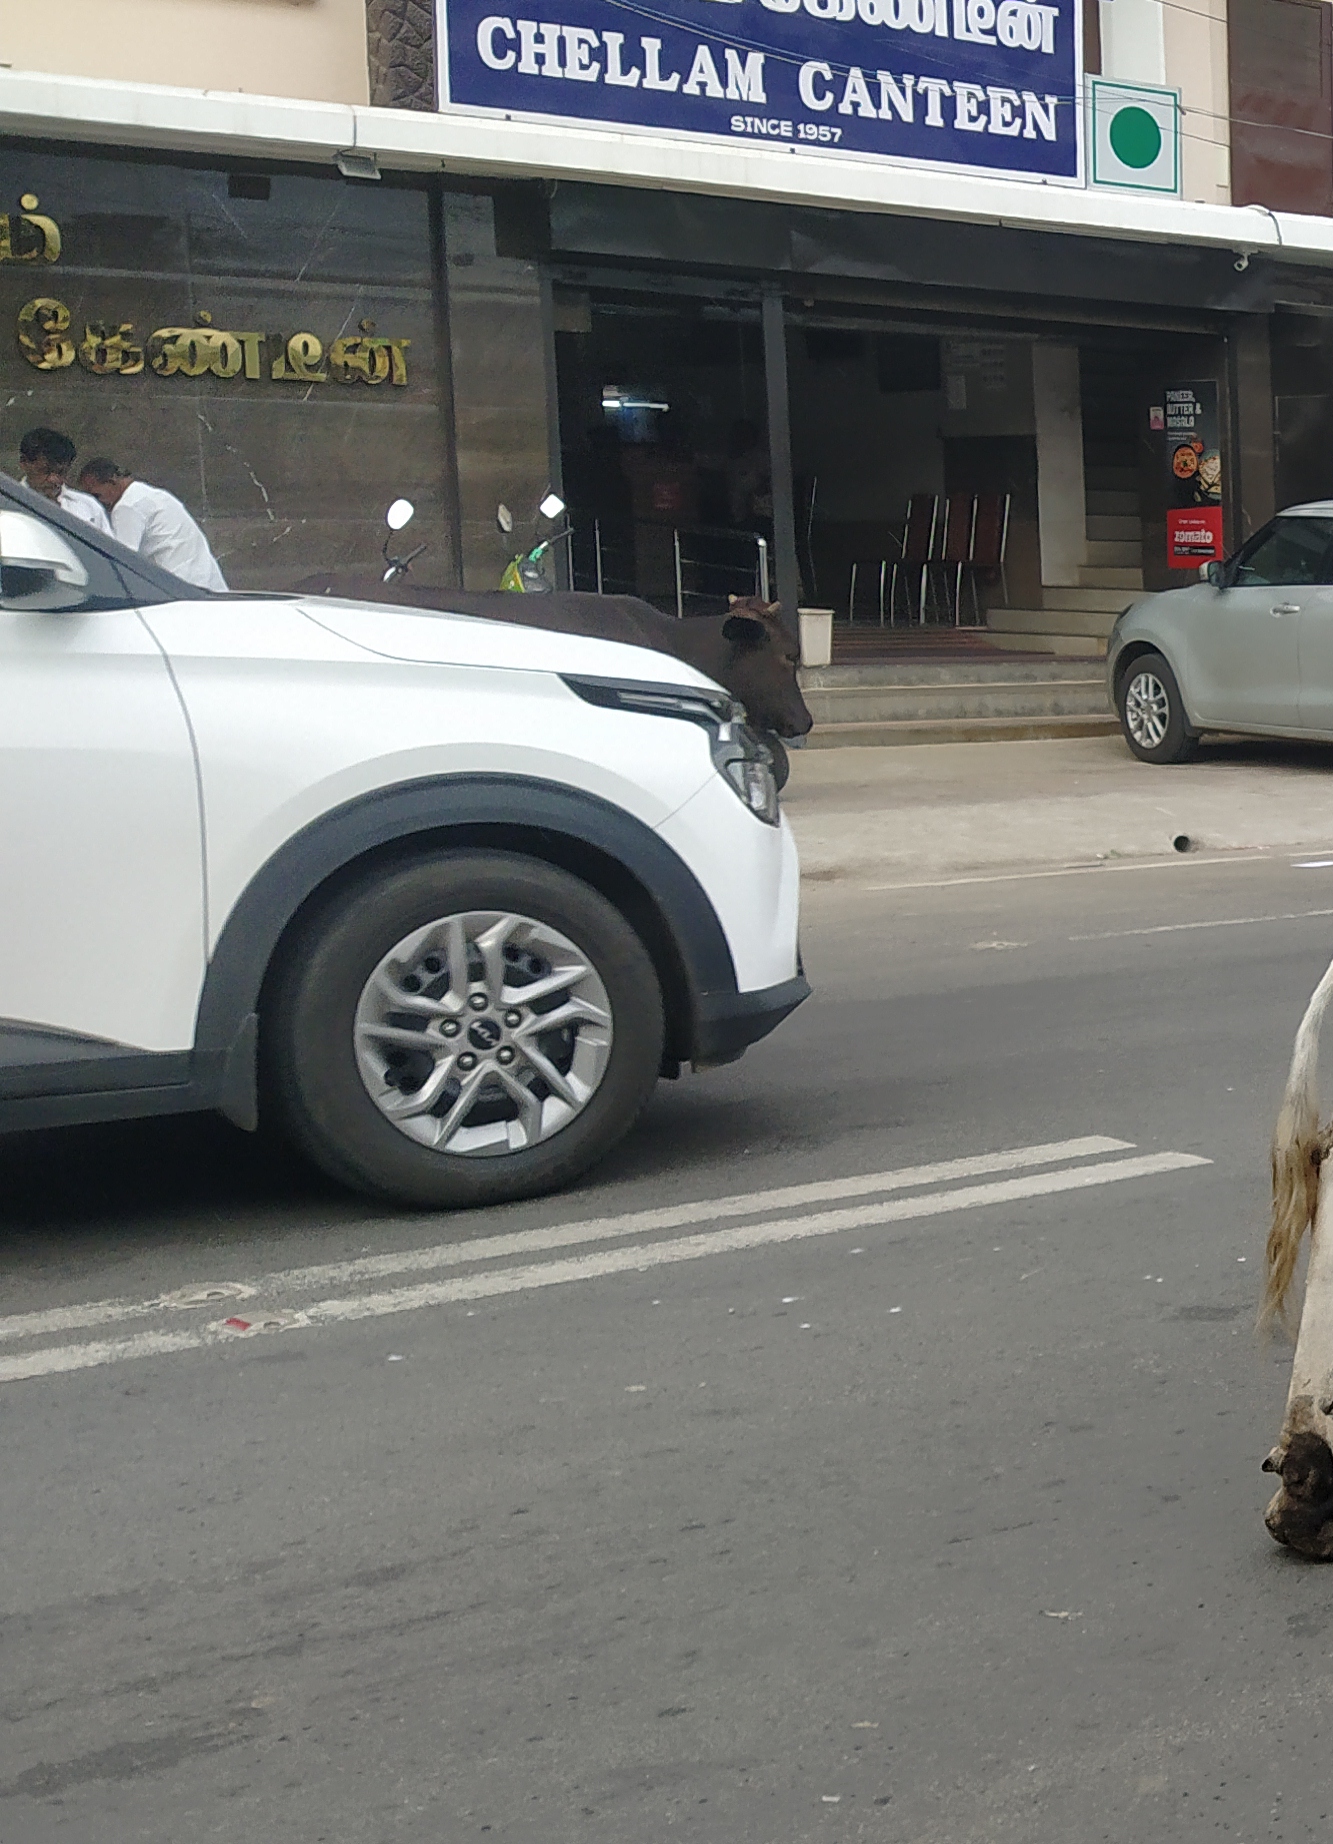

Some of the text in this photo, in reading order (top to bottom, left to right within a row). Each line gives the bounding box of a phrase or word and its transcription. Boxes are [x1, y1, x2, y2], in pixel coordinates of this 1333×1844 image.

[476, 16, 1059, 142] CHELLAM CANTEEN
[730, 115, 843, 143] SINCE 1957
[17, 298, 411, 387] கேண்டீன்
